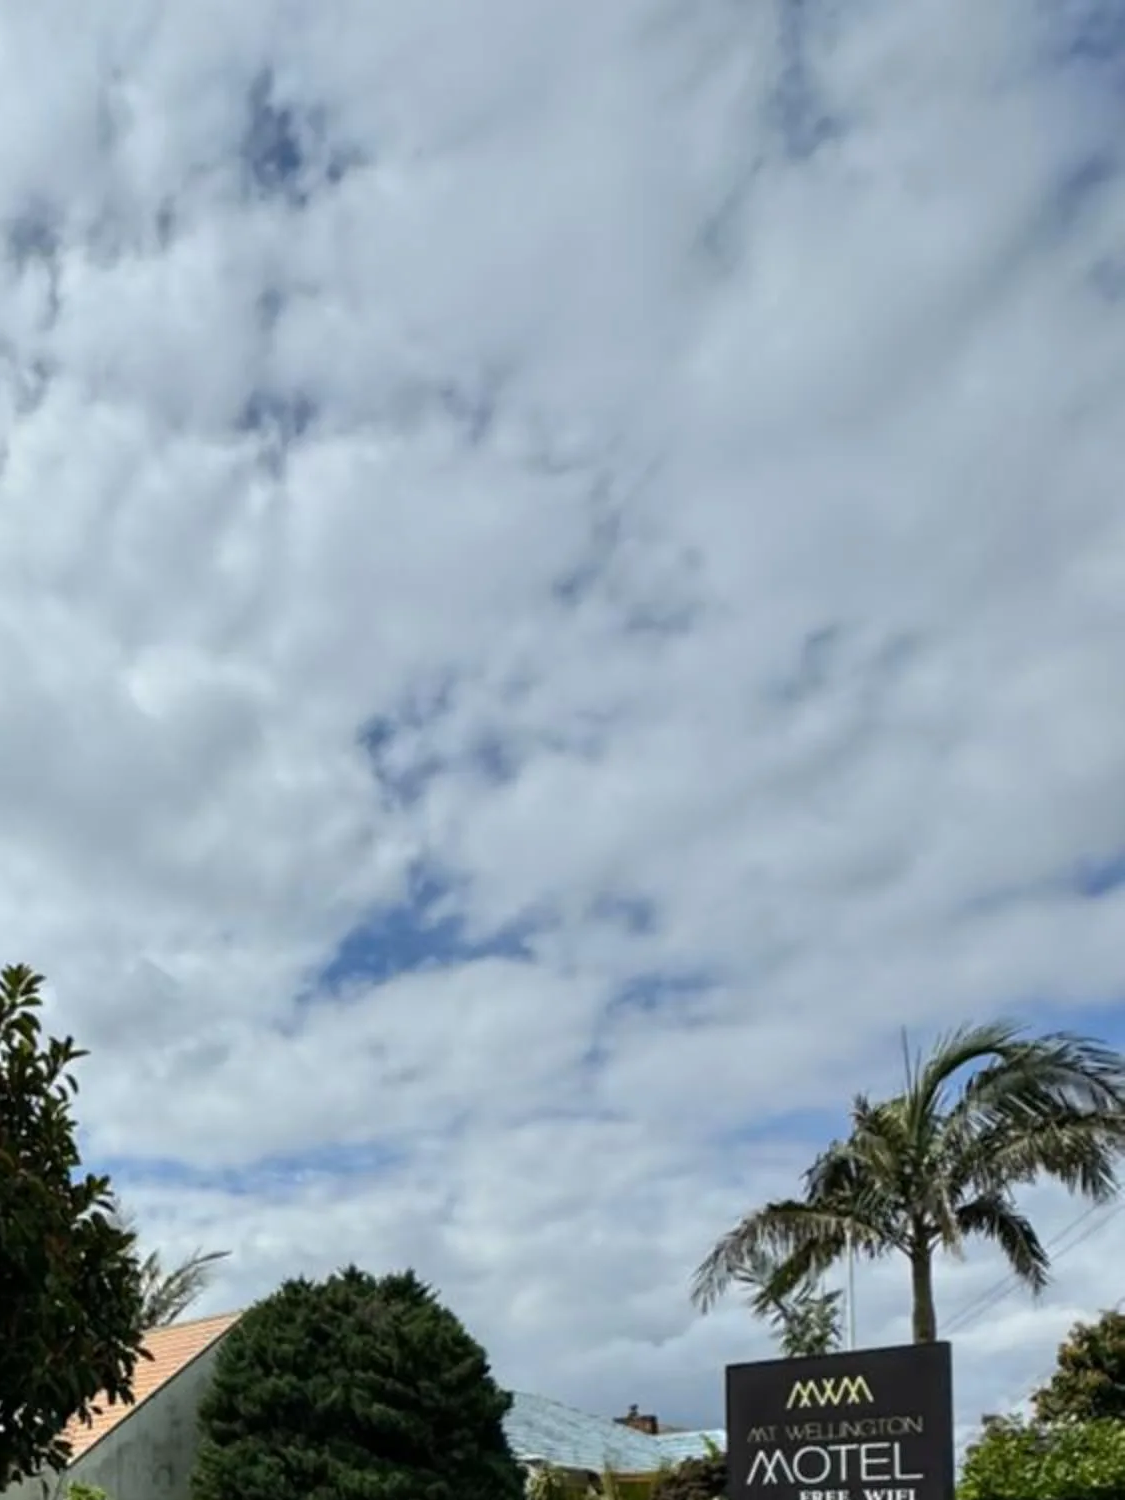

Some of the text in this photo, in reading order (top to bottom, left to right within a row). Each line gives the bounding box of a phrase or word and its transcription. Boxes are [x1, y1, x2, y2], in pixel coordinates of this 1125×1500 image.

[747, 1415, 923, 1442] MT WELLINGTON
[746, 1442, 924, 1485] MOTEL
